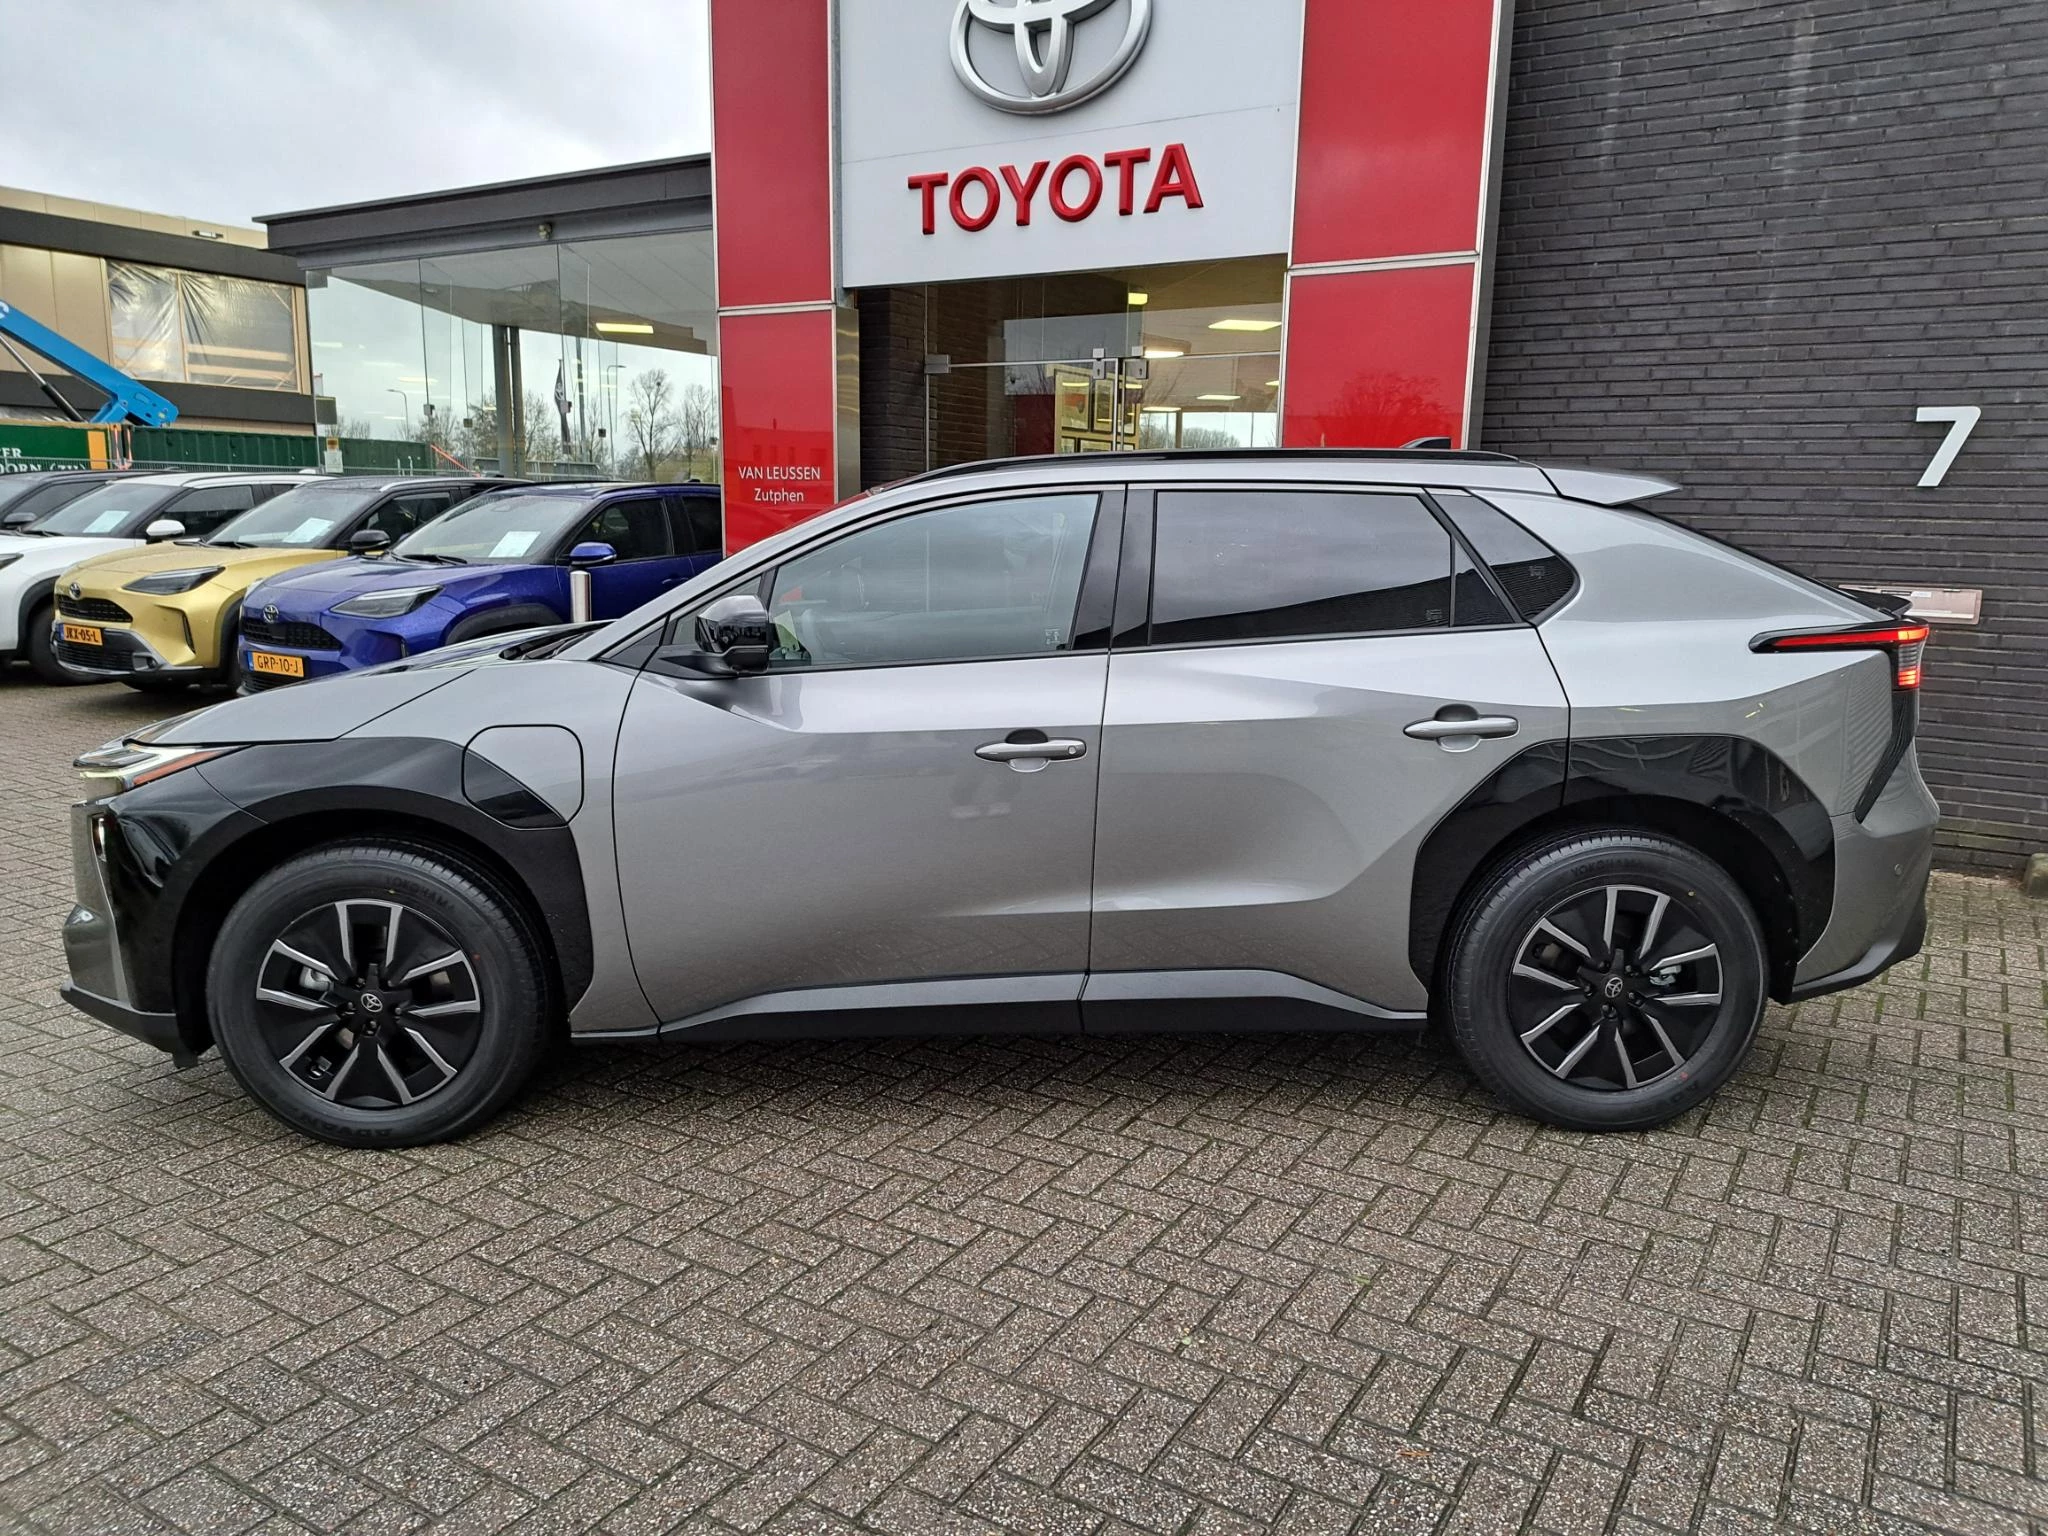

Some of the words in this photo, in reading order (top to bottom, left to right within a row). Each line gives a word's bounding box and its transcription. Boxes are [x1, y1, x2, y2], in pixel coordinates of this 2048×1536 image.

[908, 143, 1204, 235] TOYOTA
[1916, 406, 1981, 487] 7
[738, 466, 763, 480] VAN
[766, 466, 821, 480] LEUSSEN
[754, 487, 804, 504] Zutphen
[66, 626, 99, 643] JKX-05-L
[257, 655, 299, 674] GRP-10-J
